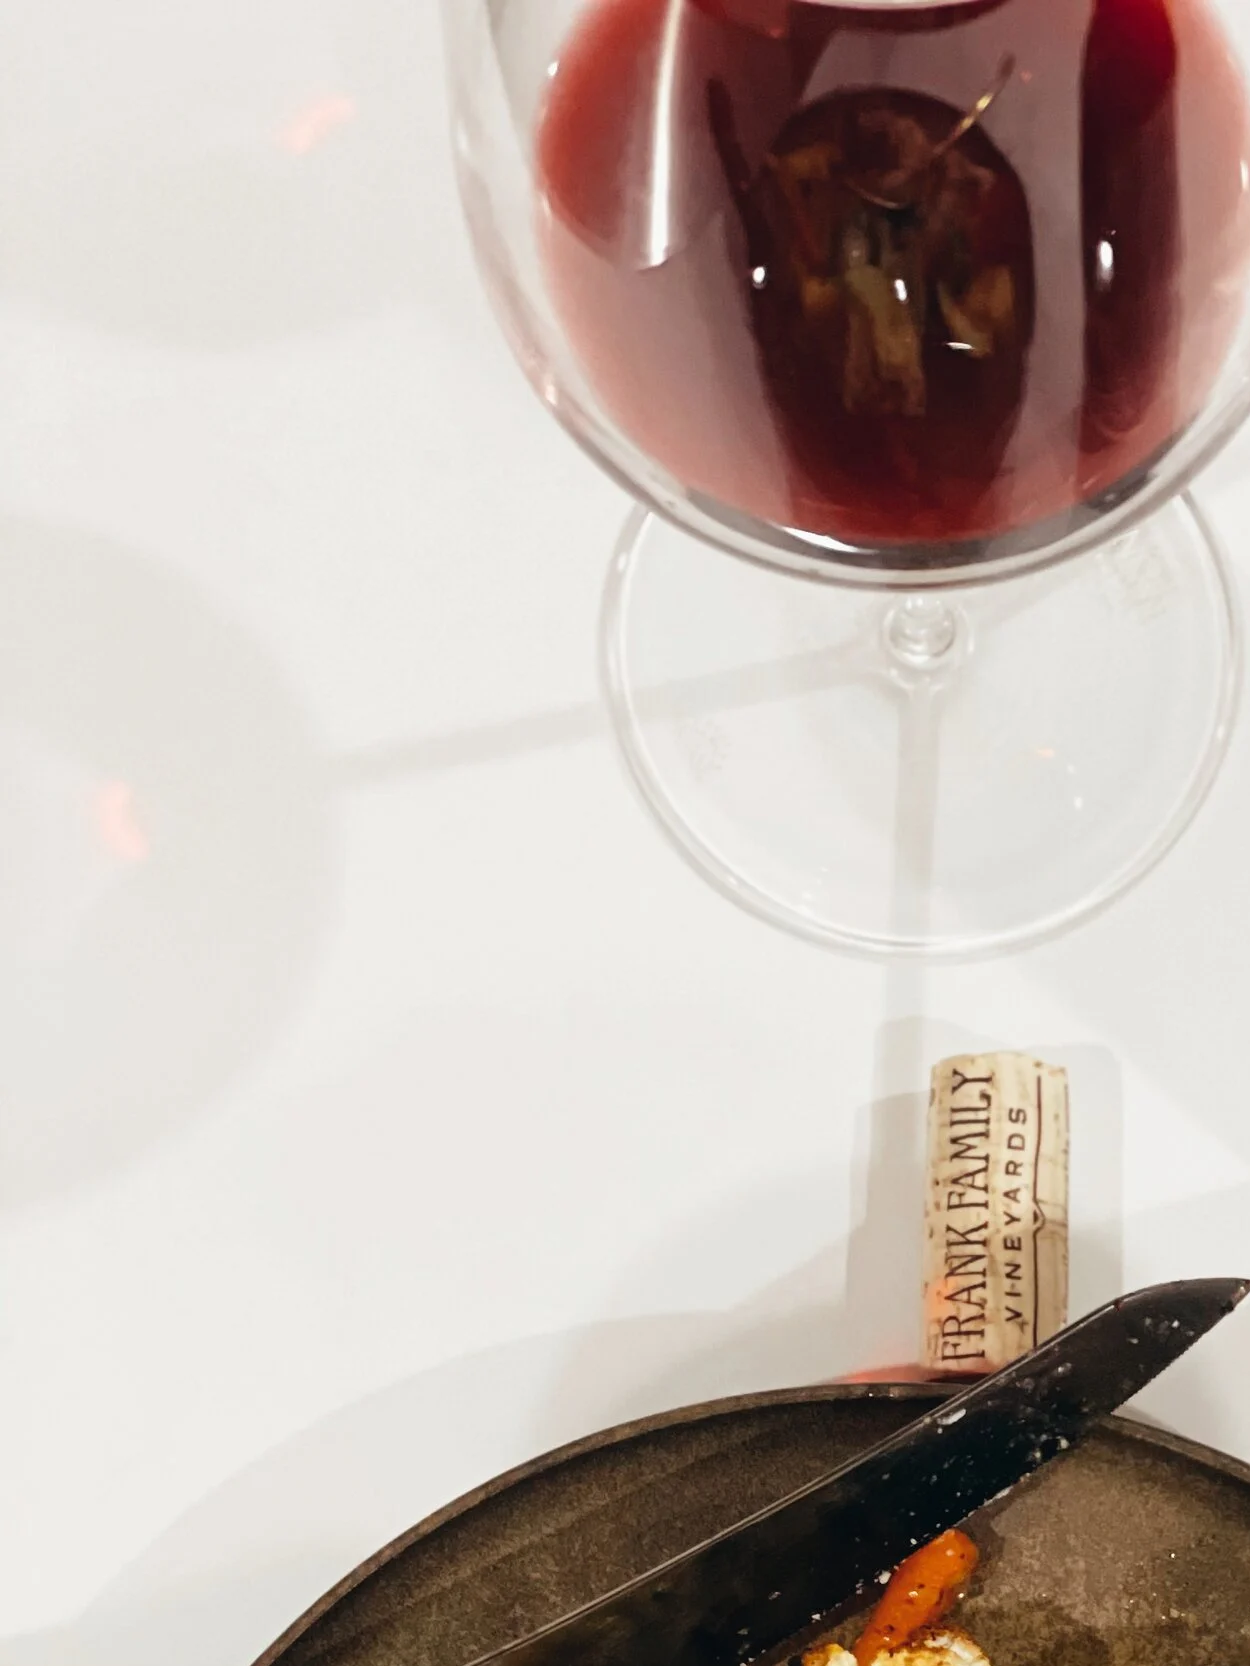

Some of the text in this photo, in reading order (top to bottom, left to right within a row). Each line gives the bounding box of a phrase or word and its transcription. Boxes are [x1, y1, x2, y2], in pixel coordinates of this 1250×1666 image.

[941, 1068, 993, 1362] FRANK FAMILY
[1003, 1106, 1028, 1322] VINEYARDS
